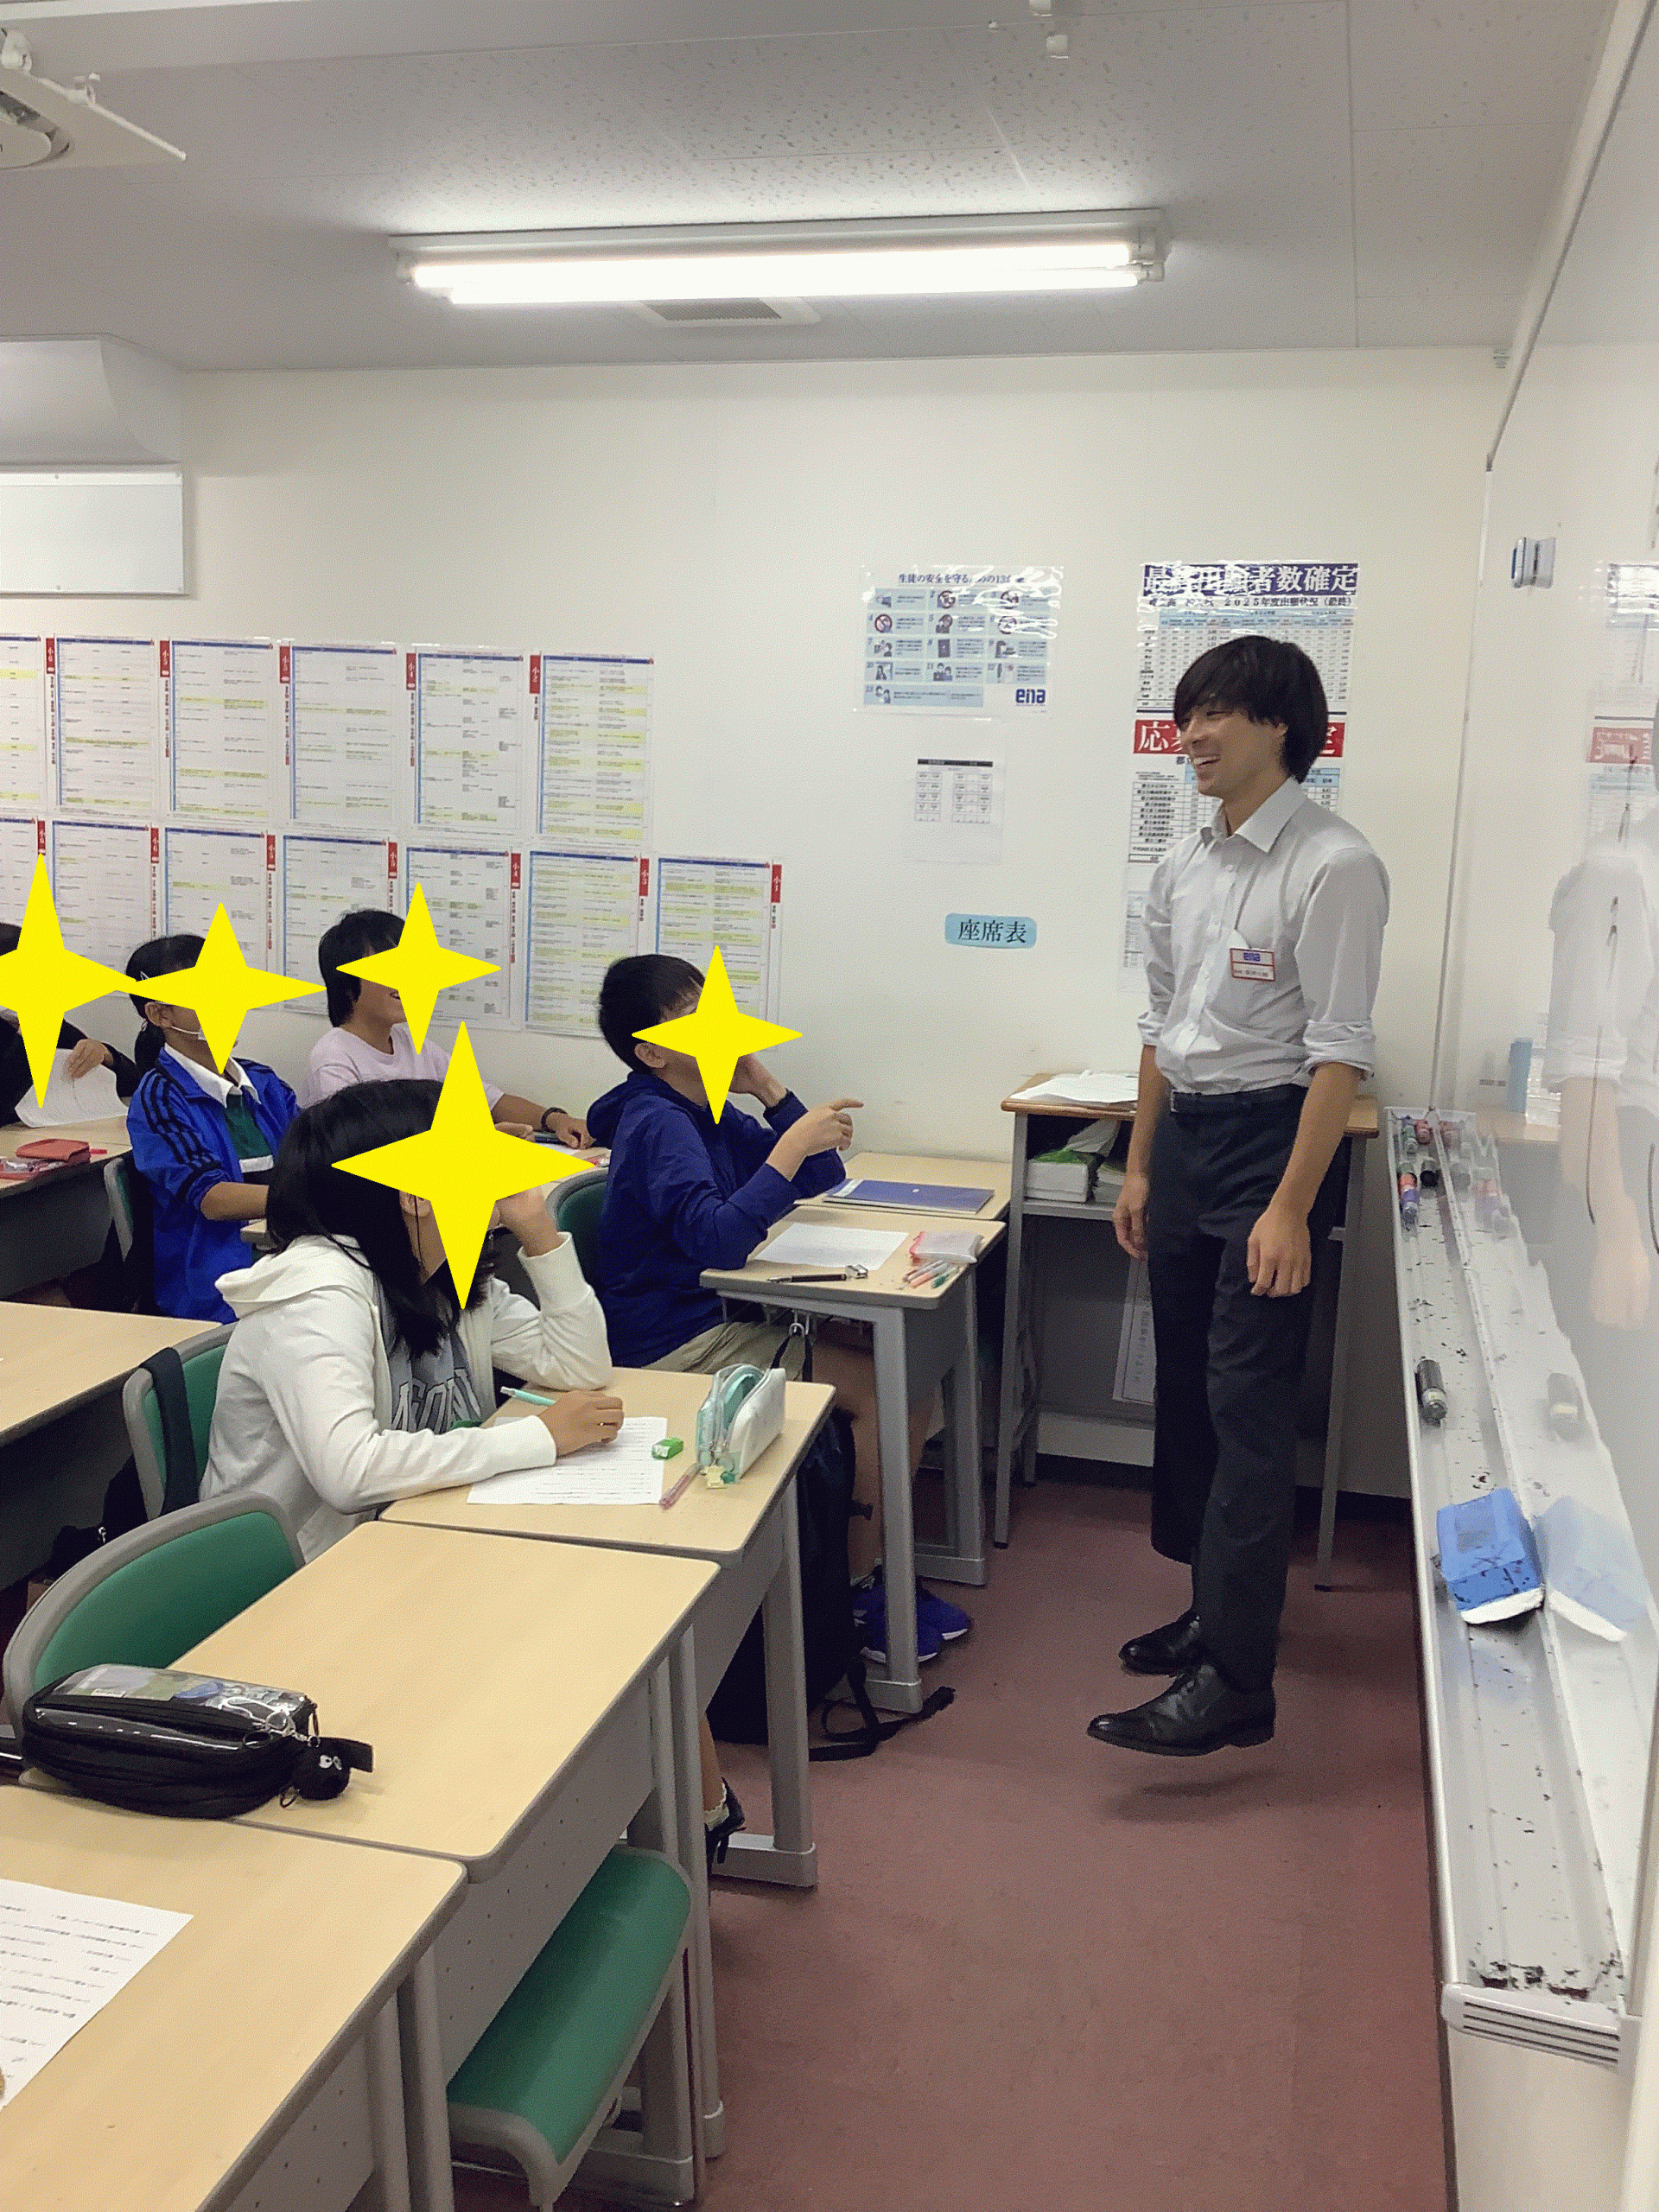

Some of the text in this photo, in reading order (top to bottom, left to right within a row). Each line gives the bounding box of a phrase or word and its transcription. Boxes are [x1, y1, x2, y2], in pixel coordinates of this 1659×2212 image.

[1015, 689, 1046, 703] ena
[958, 918, 1027, 944] 座席表
